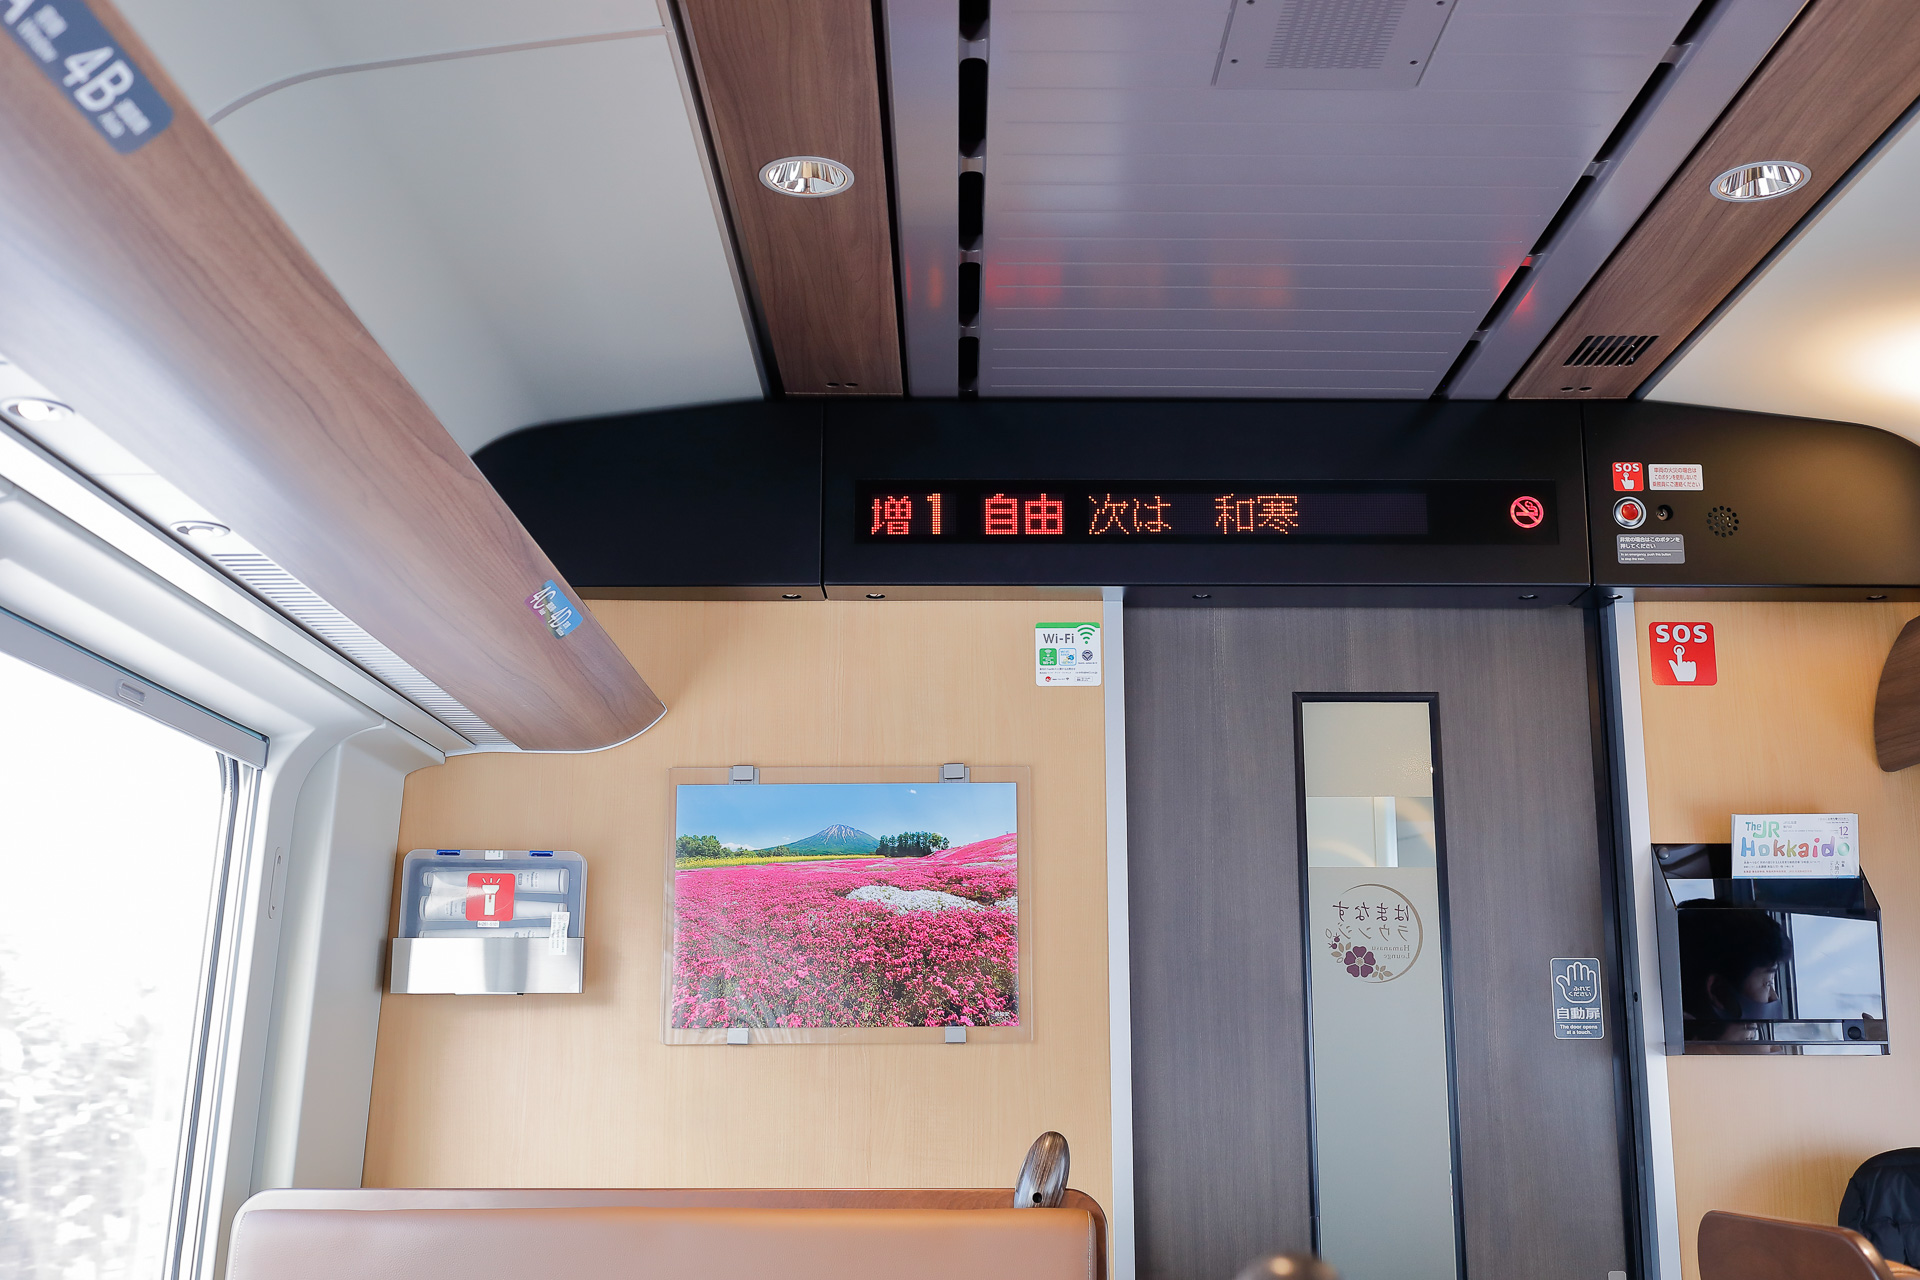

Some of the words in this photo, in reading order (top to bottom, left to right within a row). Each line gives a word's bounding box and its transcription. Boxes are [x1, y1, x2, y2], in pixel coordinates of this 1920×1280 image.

[62, 45, 135, 112] 4B
[1614, 463, 1640, 472] SOS
[985, 493, 1064, 535] 自由
[1088, 493, 1172, 535] 次は
[1215, 493, 1299, 535] 和寒
[530, 586, 557, 609] 4C
[548, 606, 573, 628] 4D
[1043, 633, 1075, 644] Wi-Fi
[1655, 624, 1708, 644] SOS
[1745, 821, 1762, 831] The
[1752, 821, 1780, 838] JR
[1839, 826, 1849, 836] 12
[1741, 836, 1850, 858] Hokkaido
[1556, 1007, 1600, 1020] 自動扉
